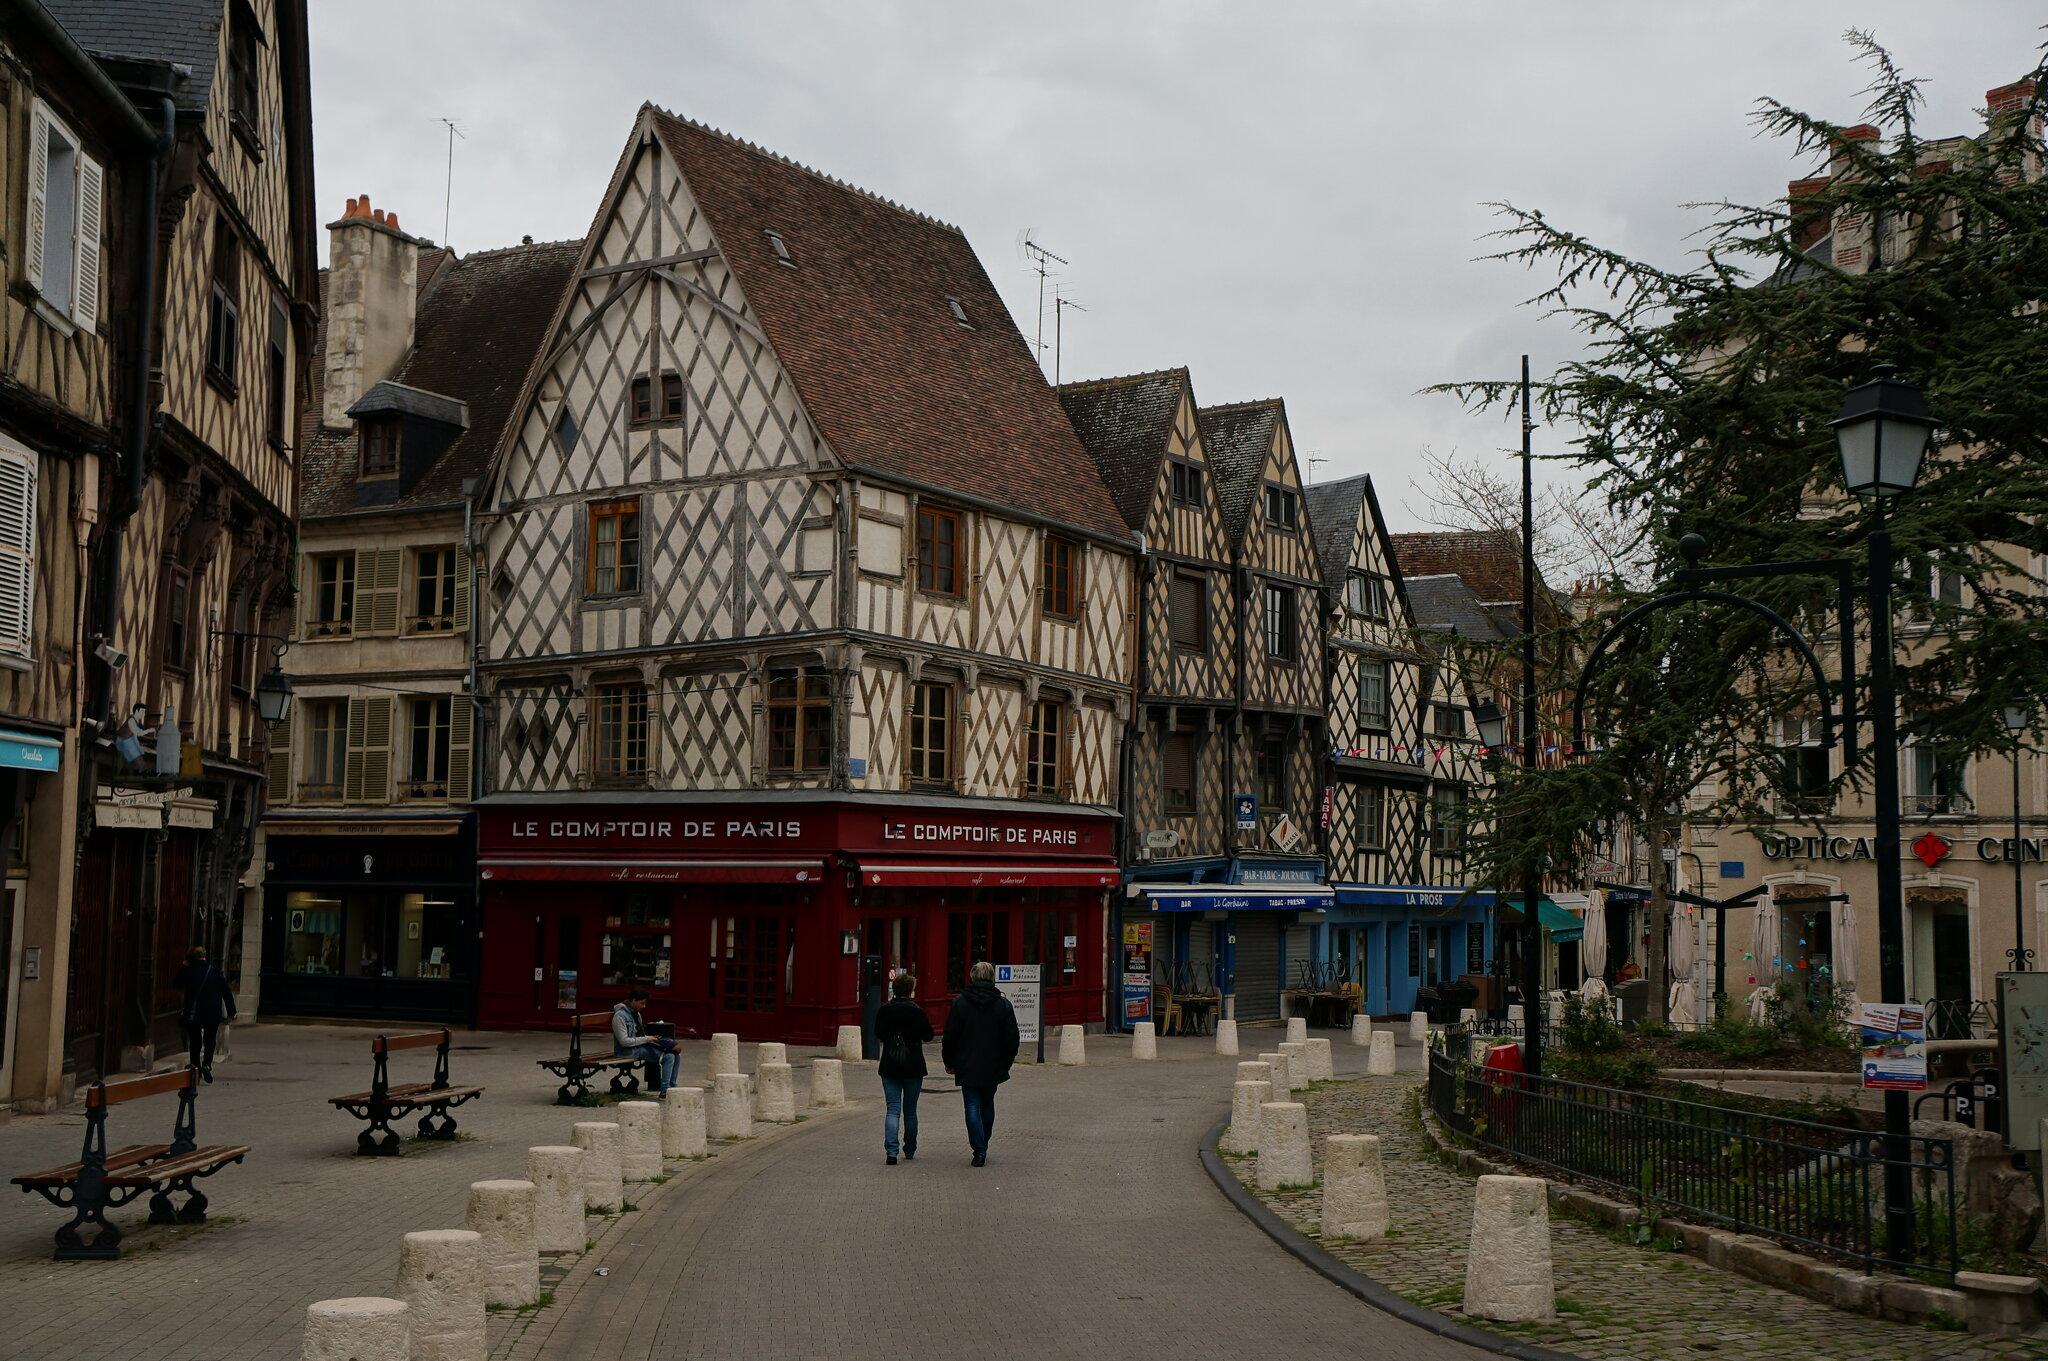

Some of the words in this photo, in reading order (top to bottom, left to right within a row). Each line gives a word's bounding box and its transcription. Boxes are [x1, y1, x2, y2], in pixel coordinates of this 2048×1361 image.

[1321, 788, 1331, 829] TABAC
[512, 821, 538, 837] LE
[550, 821, 672, 837] COMPTOIR
[684, 821, 716, 837] DE
[726, 821, 801, 837] PARIS
[884, 823, 906, 840] LE
[913, 824, 1002, 842] COMPTOIR
[1006, 828, 1027, 843] DE
[1032, 829, 1077, 845] PARIS
[1283, 832, 1299, 849] PRESSE
[1762, 836, 1879, 859] OPTICA
[610, 867, 629, 881] café
[635, 870, 680, 879] restaurant
[1180, 900, 1192, 908] BAR
[1406, 893, 1416, 905] LA
[1419, 893, 1443, 906] PROSE
[1984, 1084, 1997, 1098] P
[1956, 1097, 1969, 1113] P
